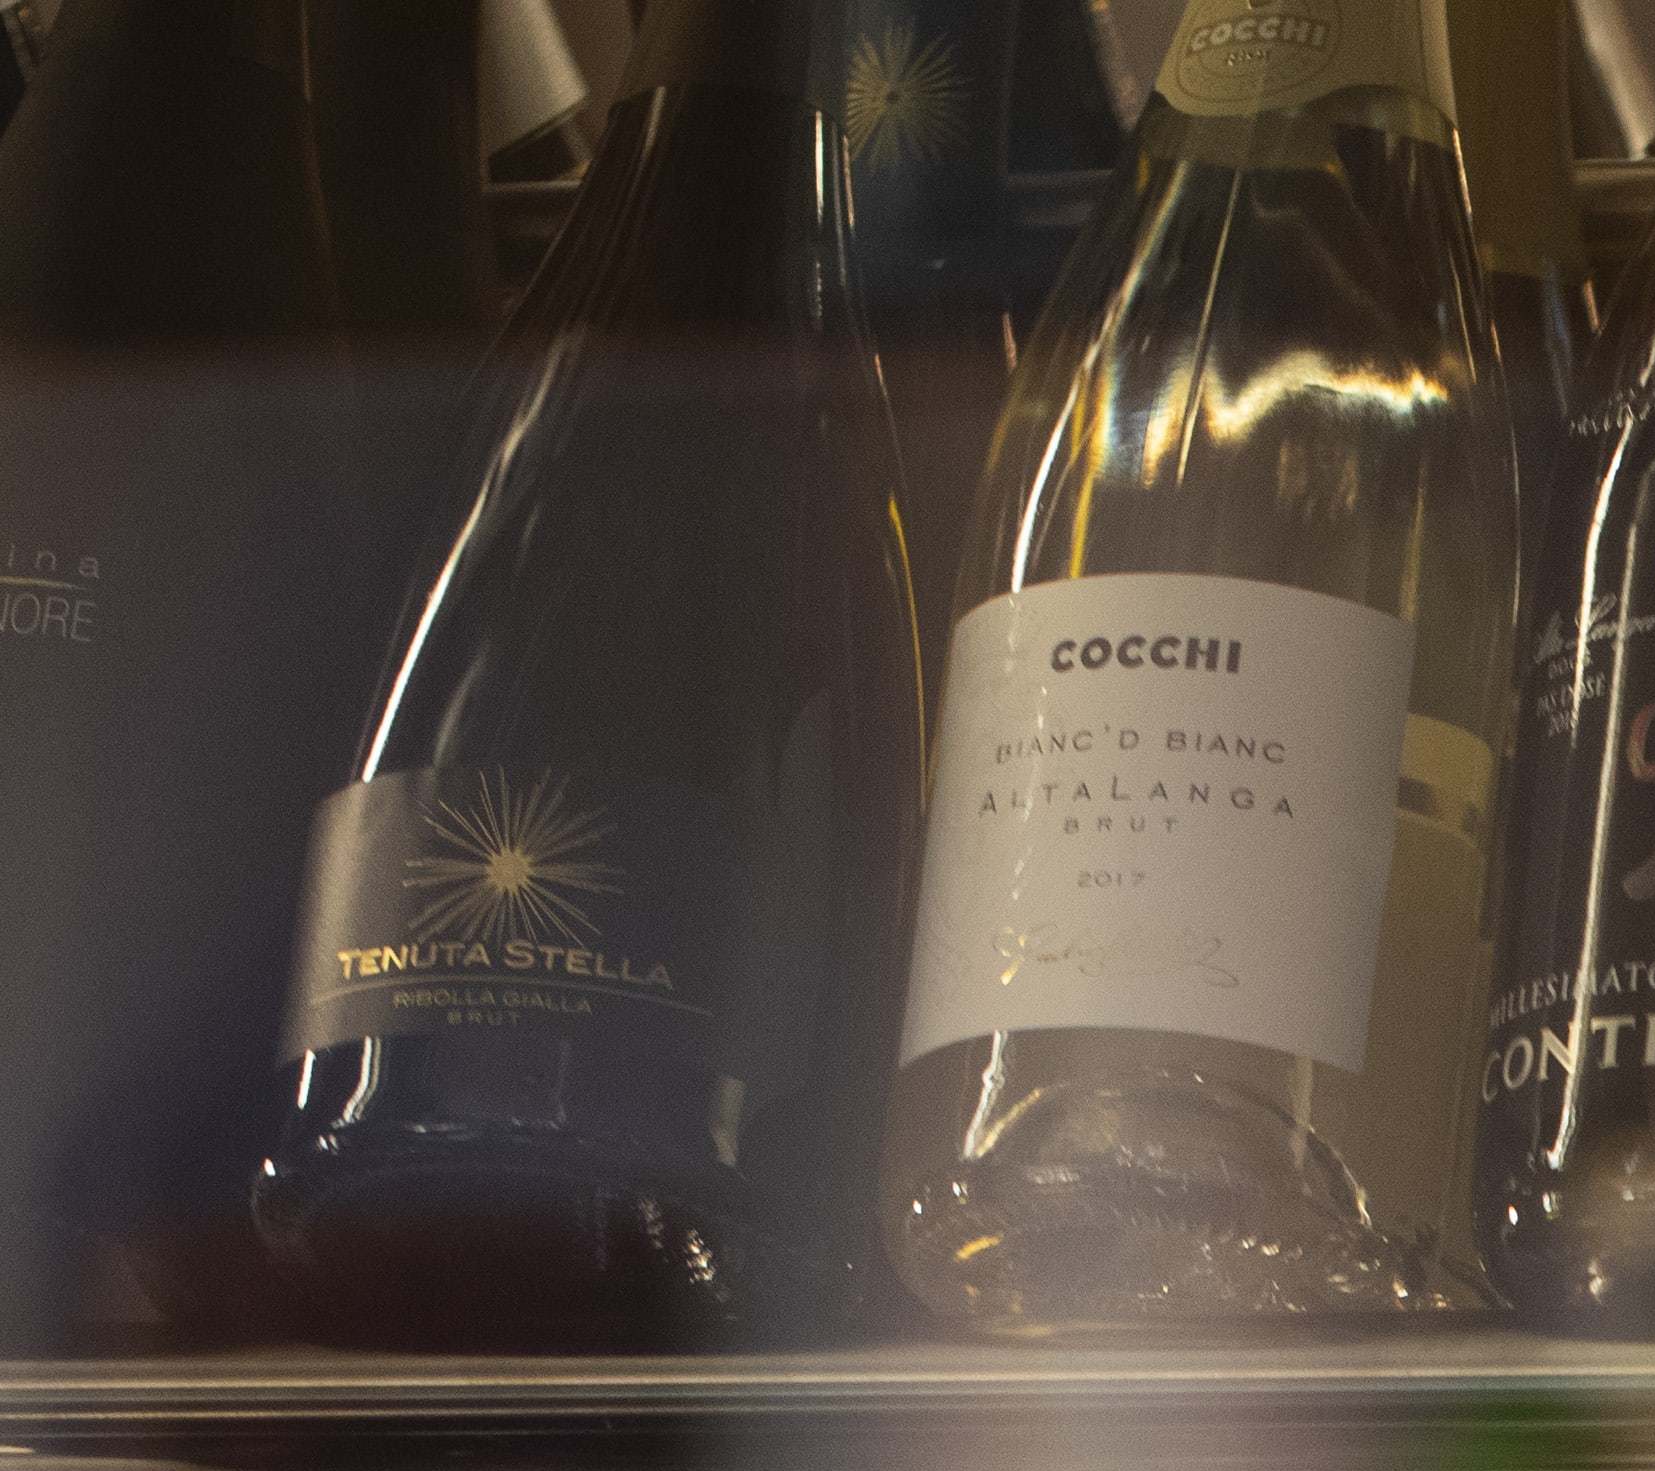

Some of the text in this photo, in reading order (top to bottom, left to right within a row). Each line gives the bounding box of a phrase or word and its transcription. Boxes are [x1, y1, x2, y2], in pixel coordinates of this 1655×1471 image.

[1191, 17, 1326, 51] COCCHI
[1051, 635, 1242, 674] COCCHI
[1165, 730, 1287, 764] BIANC
[1064, 817, 1178, 834] BRUT
[338, 938, 674, 991] TENUTA STELLA
[393, 990, 593, 1015] RIBOLLA GIALLA
[446, 1010, 521, 1026] BRUT
